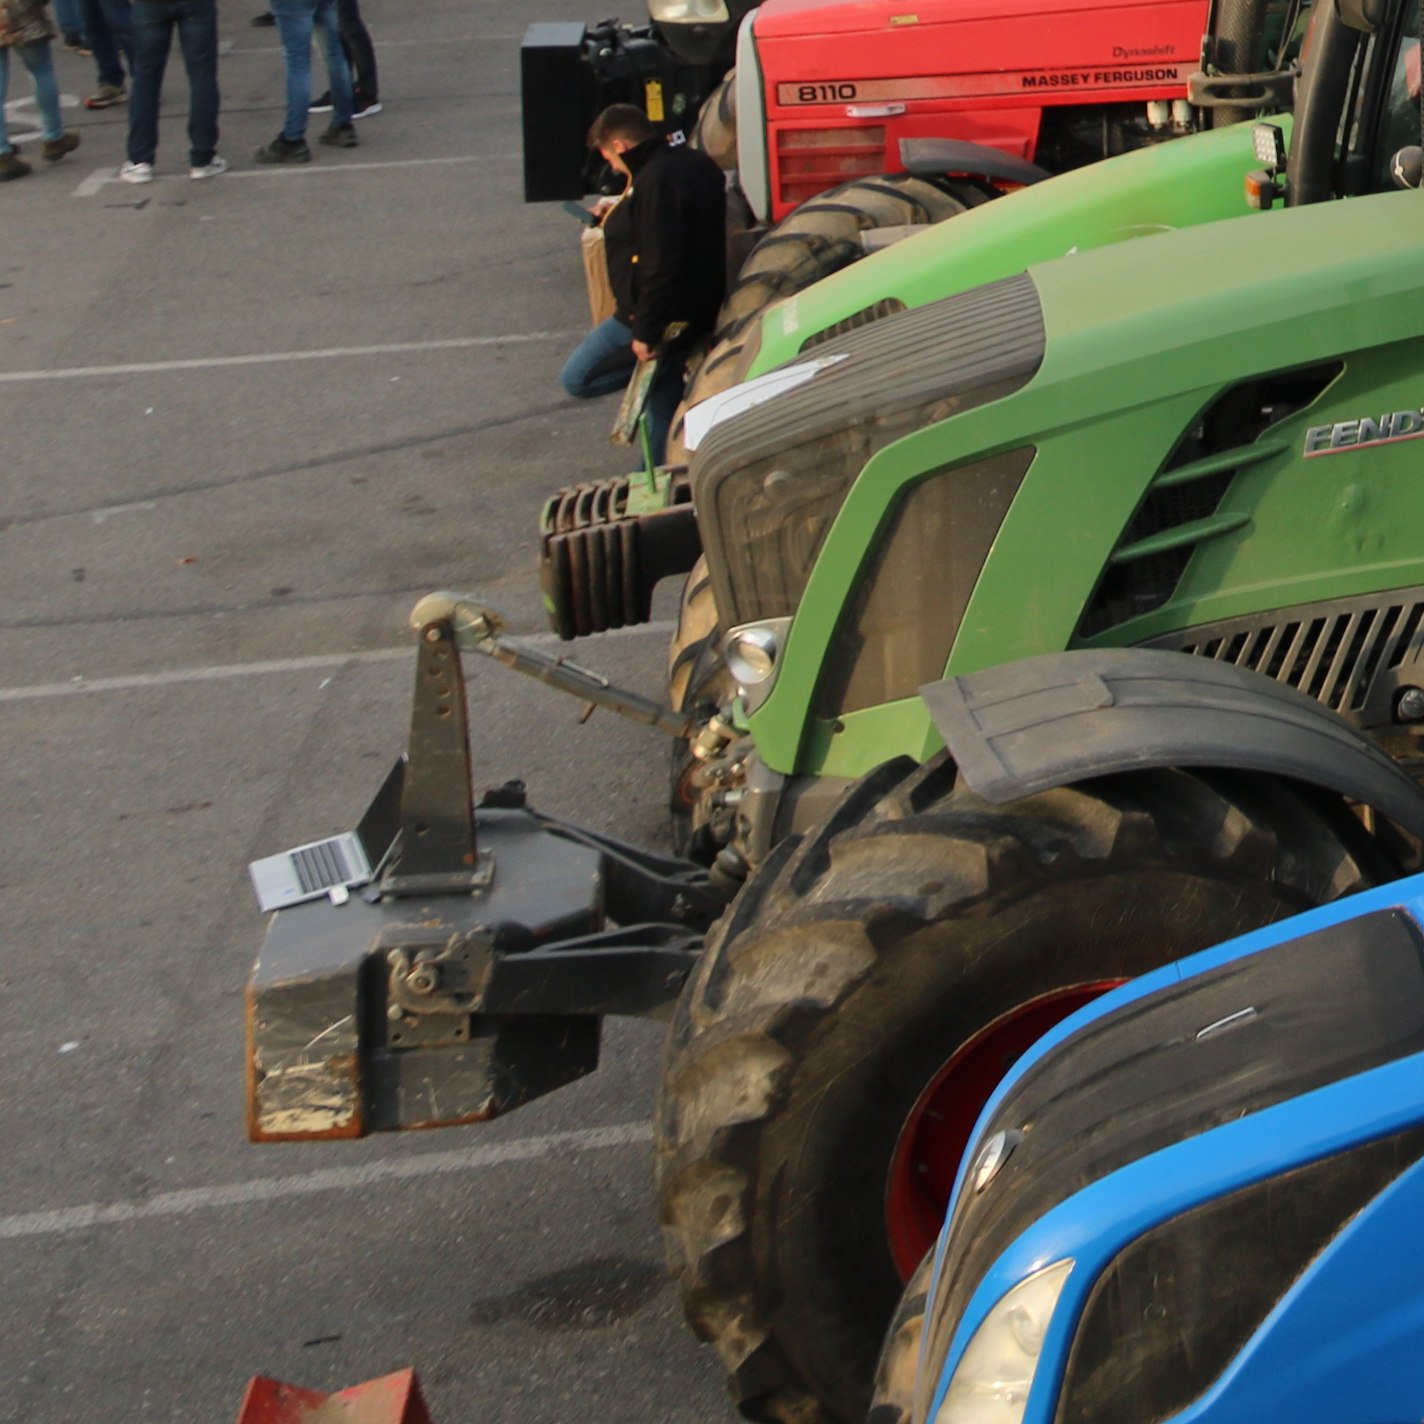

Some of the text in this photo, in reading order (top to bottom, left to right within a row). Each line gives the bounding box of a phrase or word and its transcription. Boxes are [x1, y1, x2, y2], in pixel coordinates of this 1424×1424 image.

[1022, 67, 1178, 88] MASSEY FERGUSON
[797, 83, 857, 103] 8110
